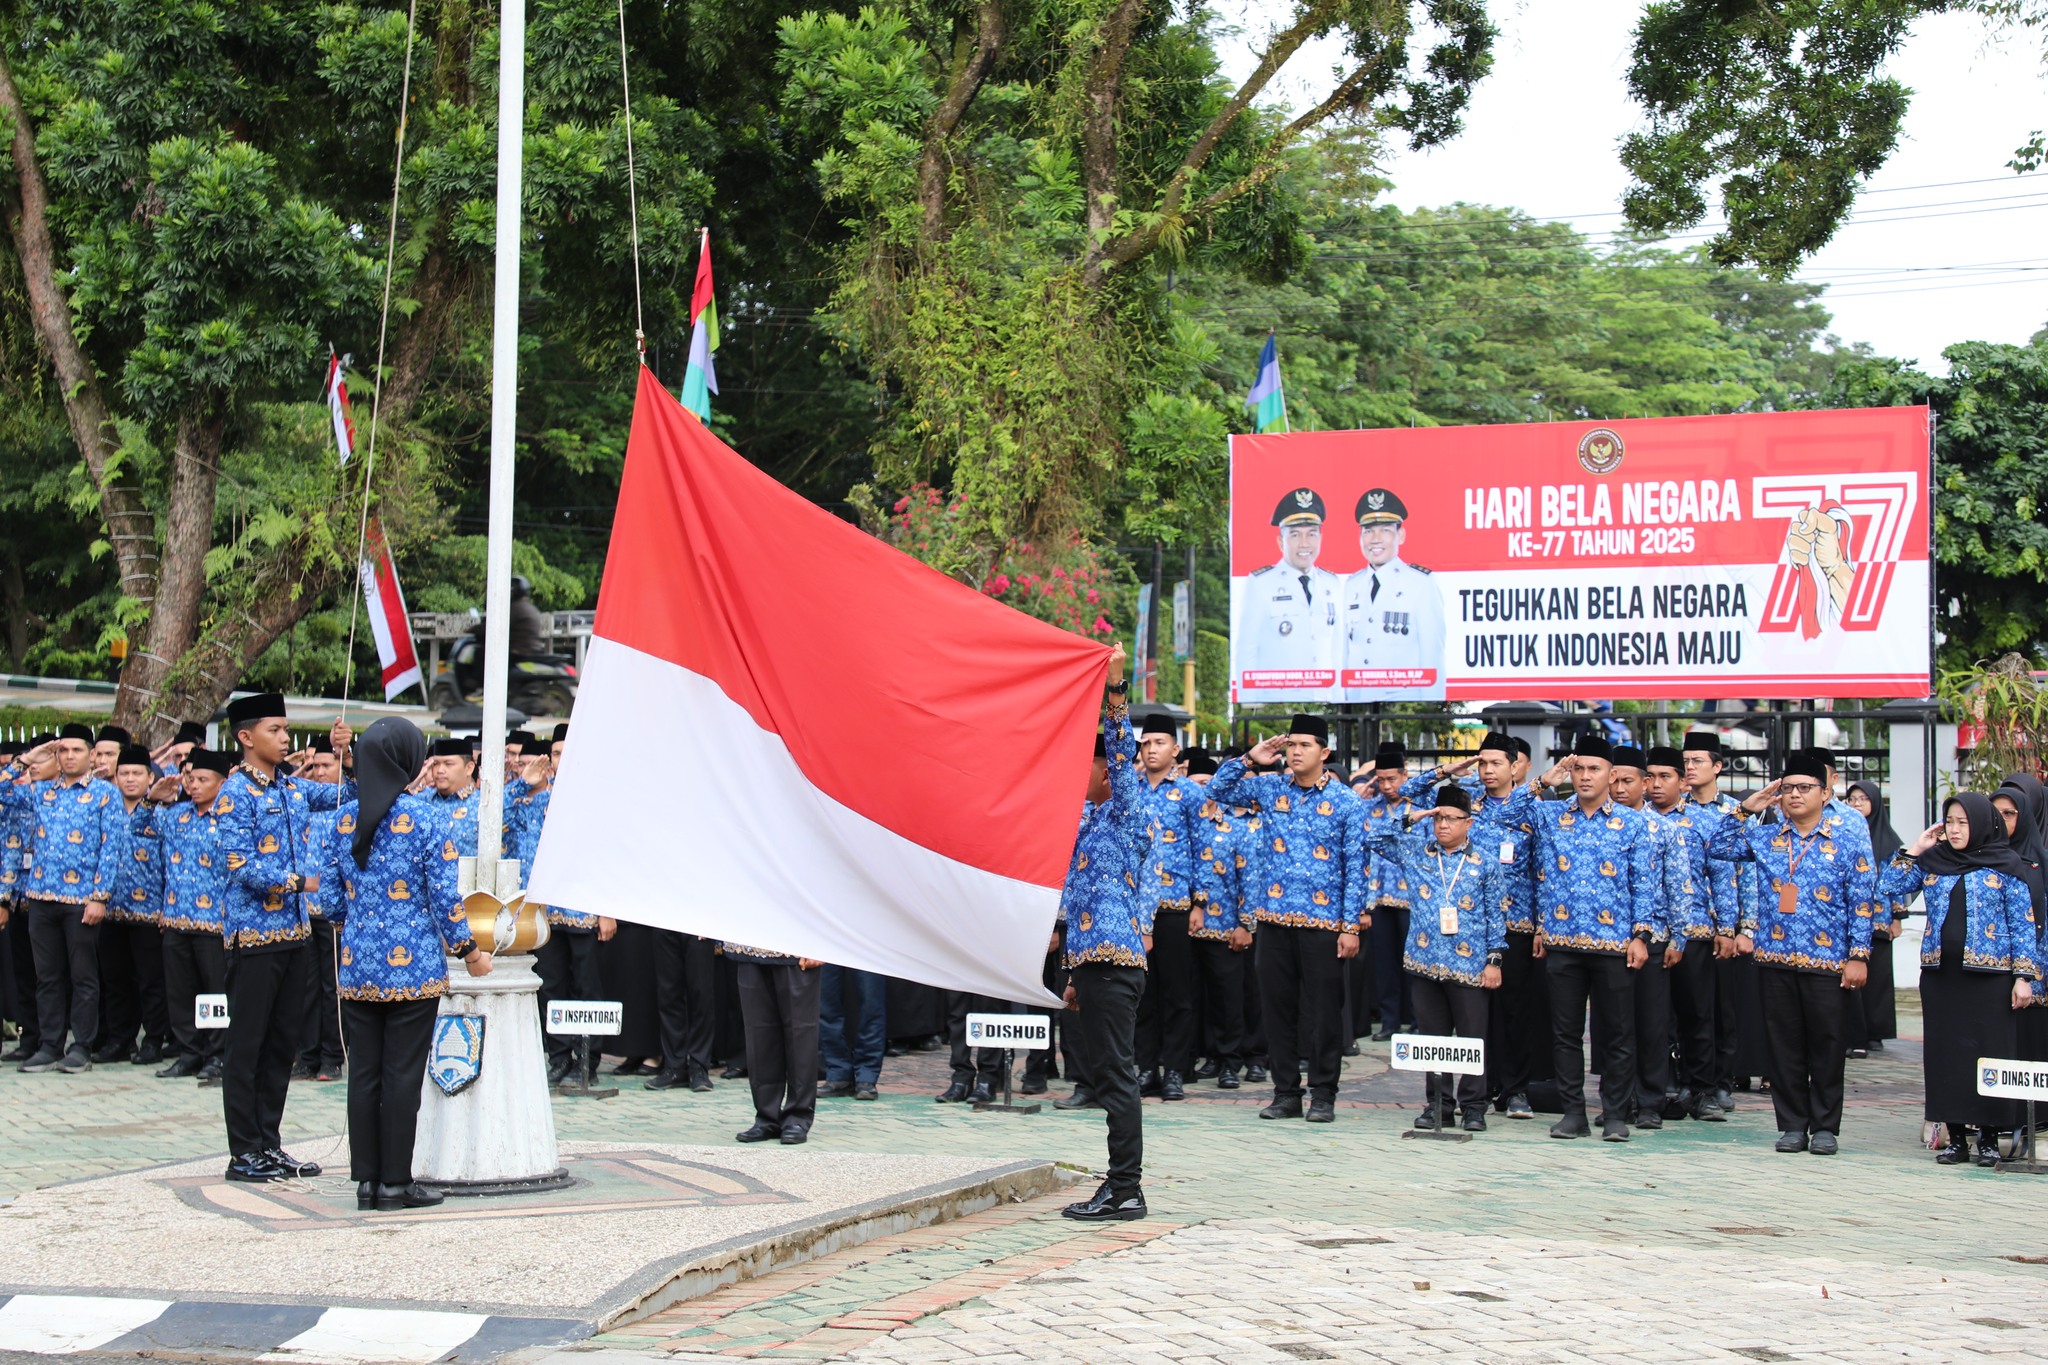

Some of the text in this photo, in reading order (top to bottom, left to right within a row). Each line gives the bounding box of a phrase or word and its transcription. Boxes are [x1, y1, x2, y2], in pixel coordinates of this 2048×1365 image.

[1464, 479, 1741, 530] HARI BELA NEGARA
[1508, 527, 1695, 558] KE-77 TAHUN 2025
[1459, 583, 1748, 622] TEGUHKAN BELA NEGARA
[1465, 630, 1742, 668] UNTUK INDONESIA MAJU
[564, 1010, 619, 1024] INSPEKTORAT
[986, 1024, 1046, 1039] DISHUB
[1412, 1046, 1481, 1063] DISPORAPAR
[2001, 1070, 2030, 1087] DINAS
